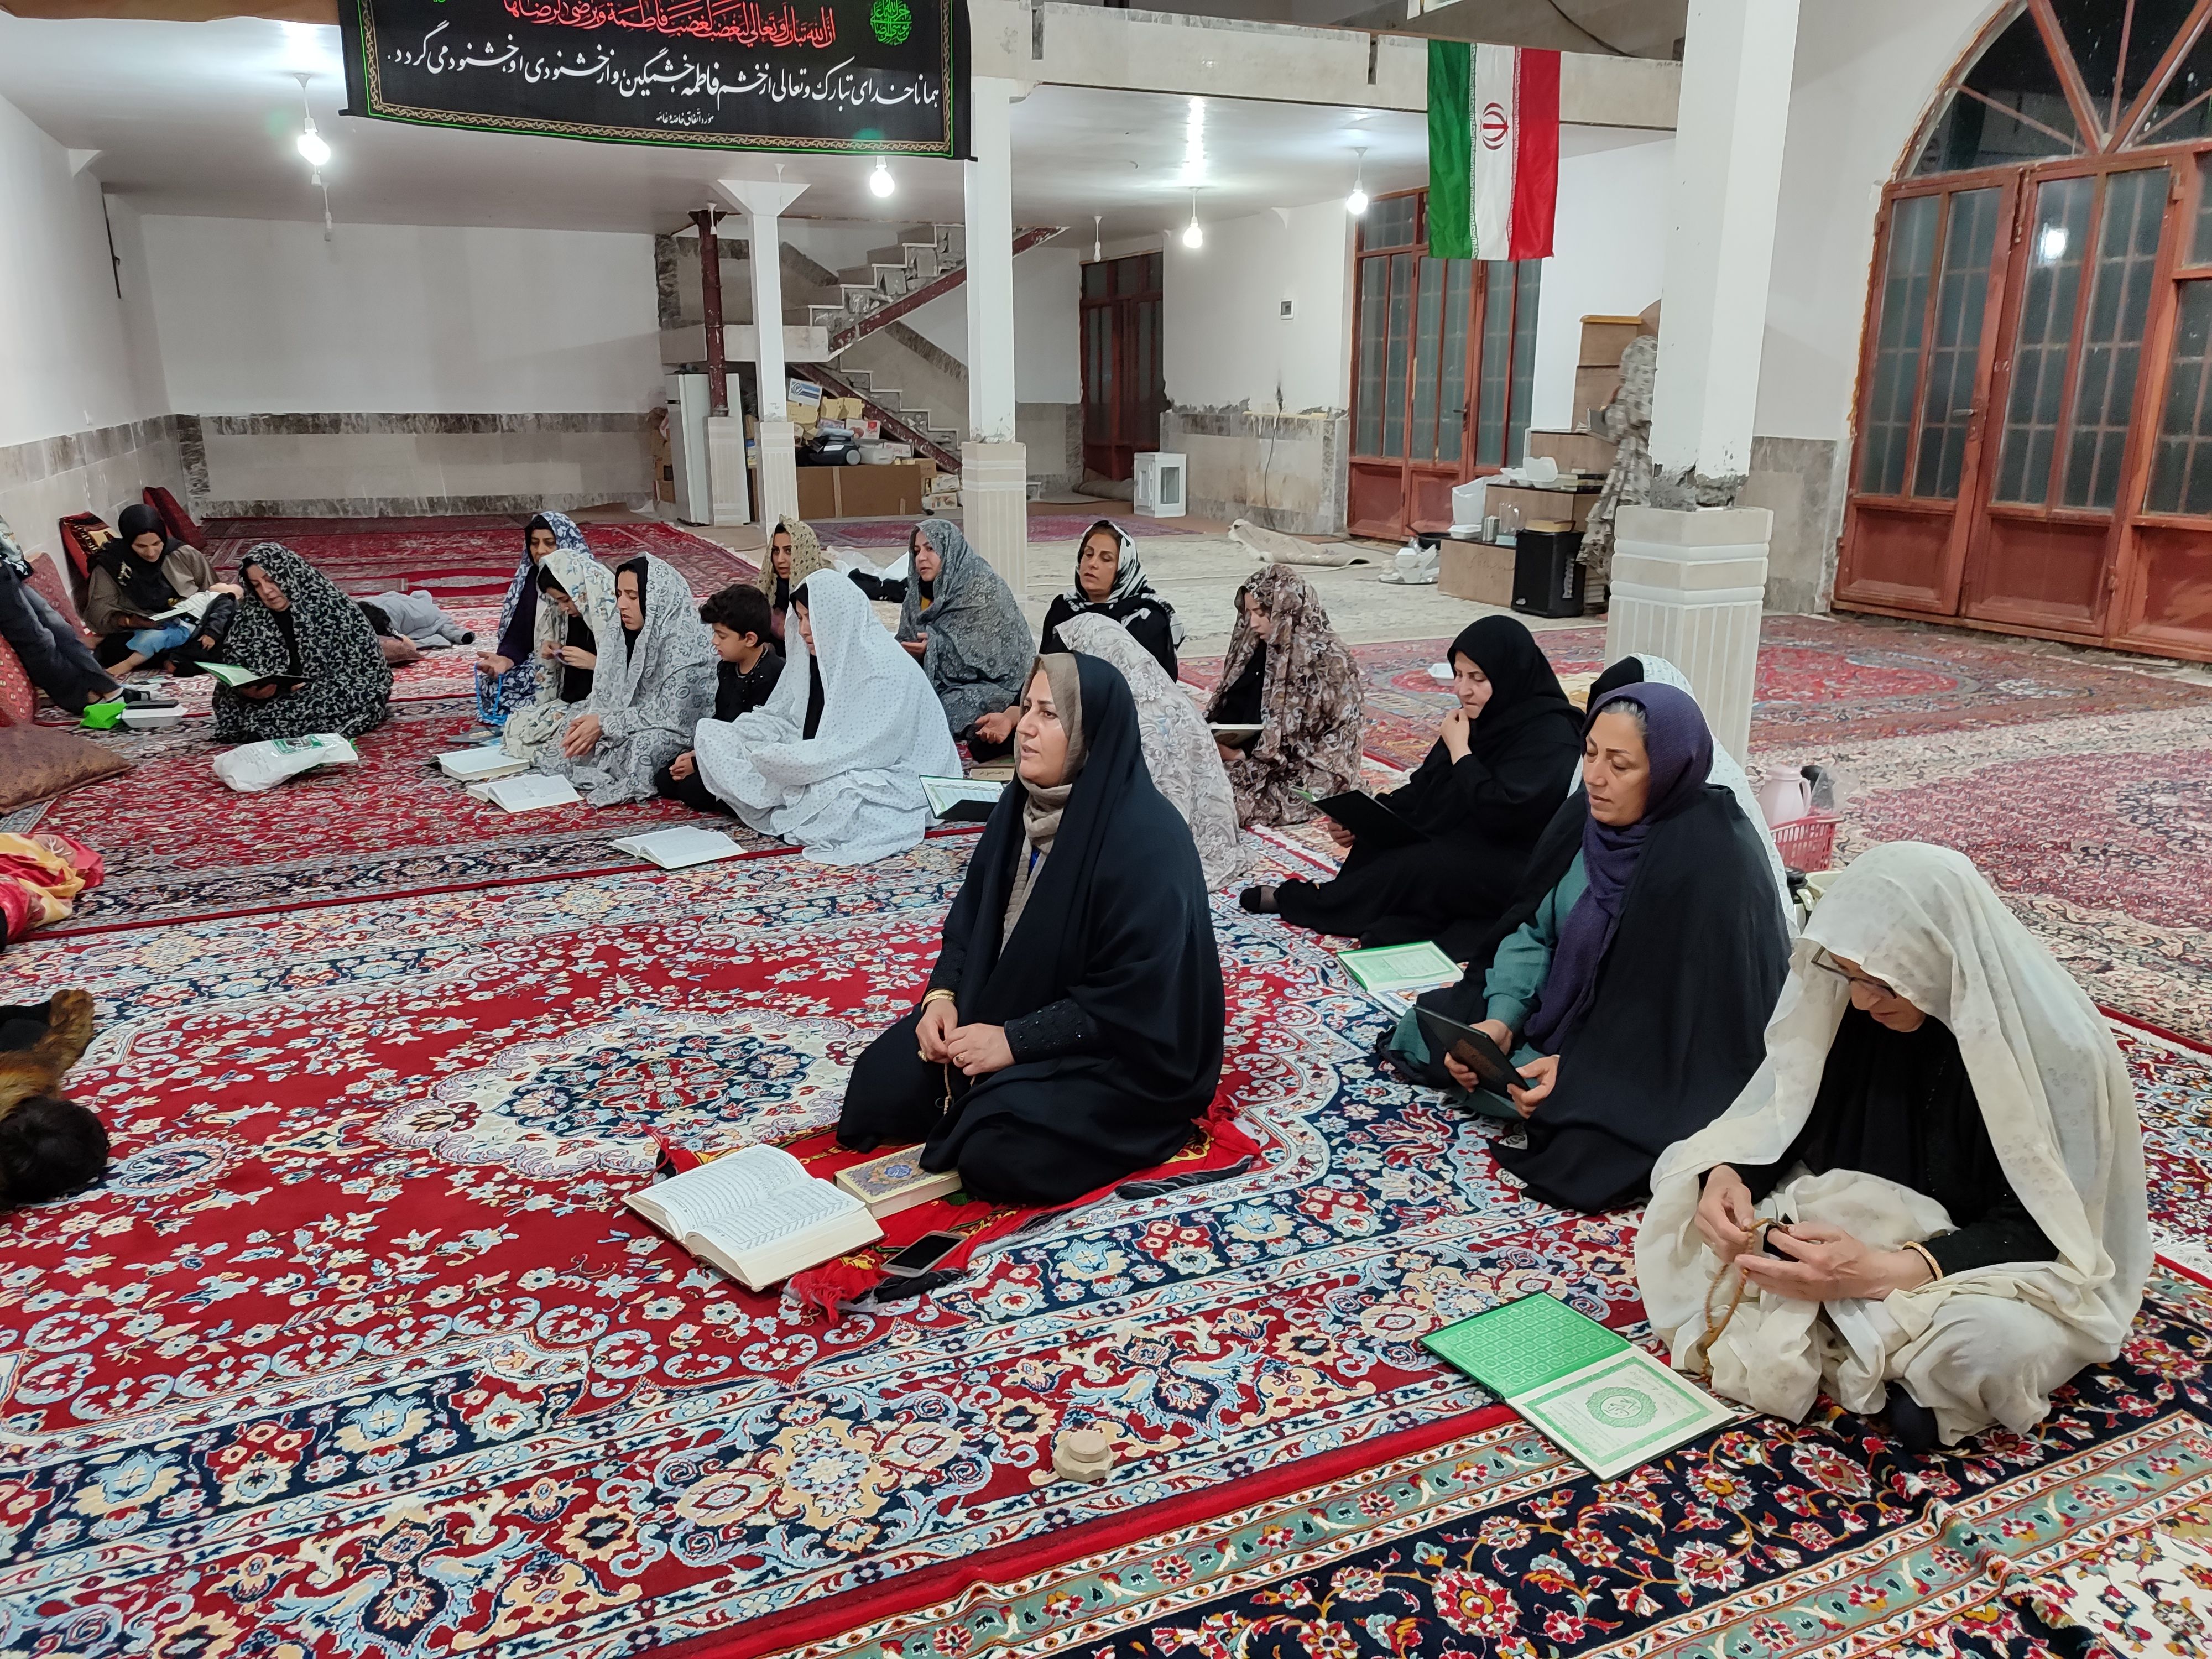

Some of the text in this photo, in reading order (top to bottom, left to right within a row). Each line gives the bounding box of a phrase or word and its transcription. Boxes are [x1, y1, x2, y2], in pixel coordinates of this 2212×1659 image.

[807, 6, 827, 42] الله
[448, 33, 519, 72] خشنود
[525, 44, 610, 83] خشنودی
[717, 63, 768, 111] خشم
[758, 62, 771, 95] از
[812, 55, 855, 112] تبارک
[851, 77, 914, 106] خدای
[915, 74, 939, 108] همانا
